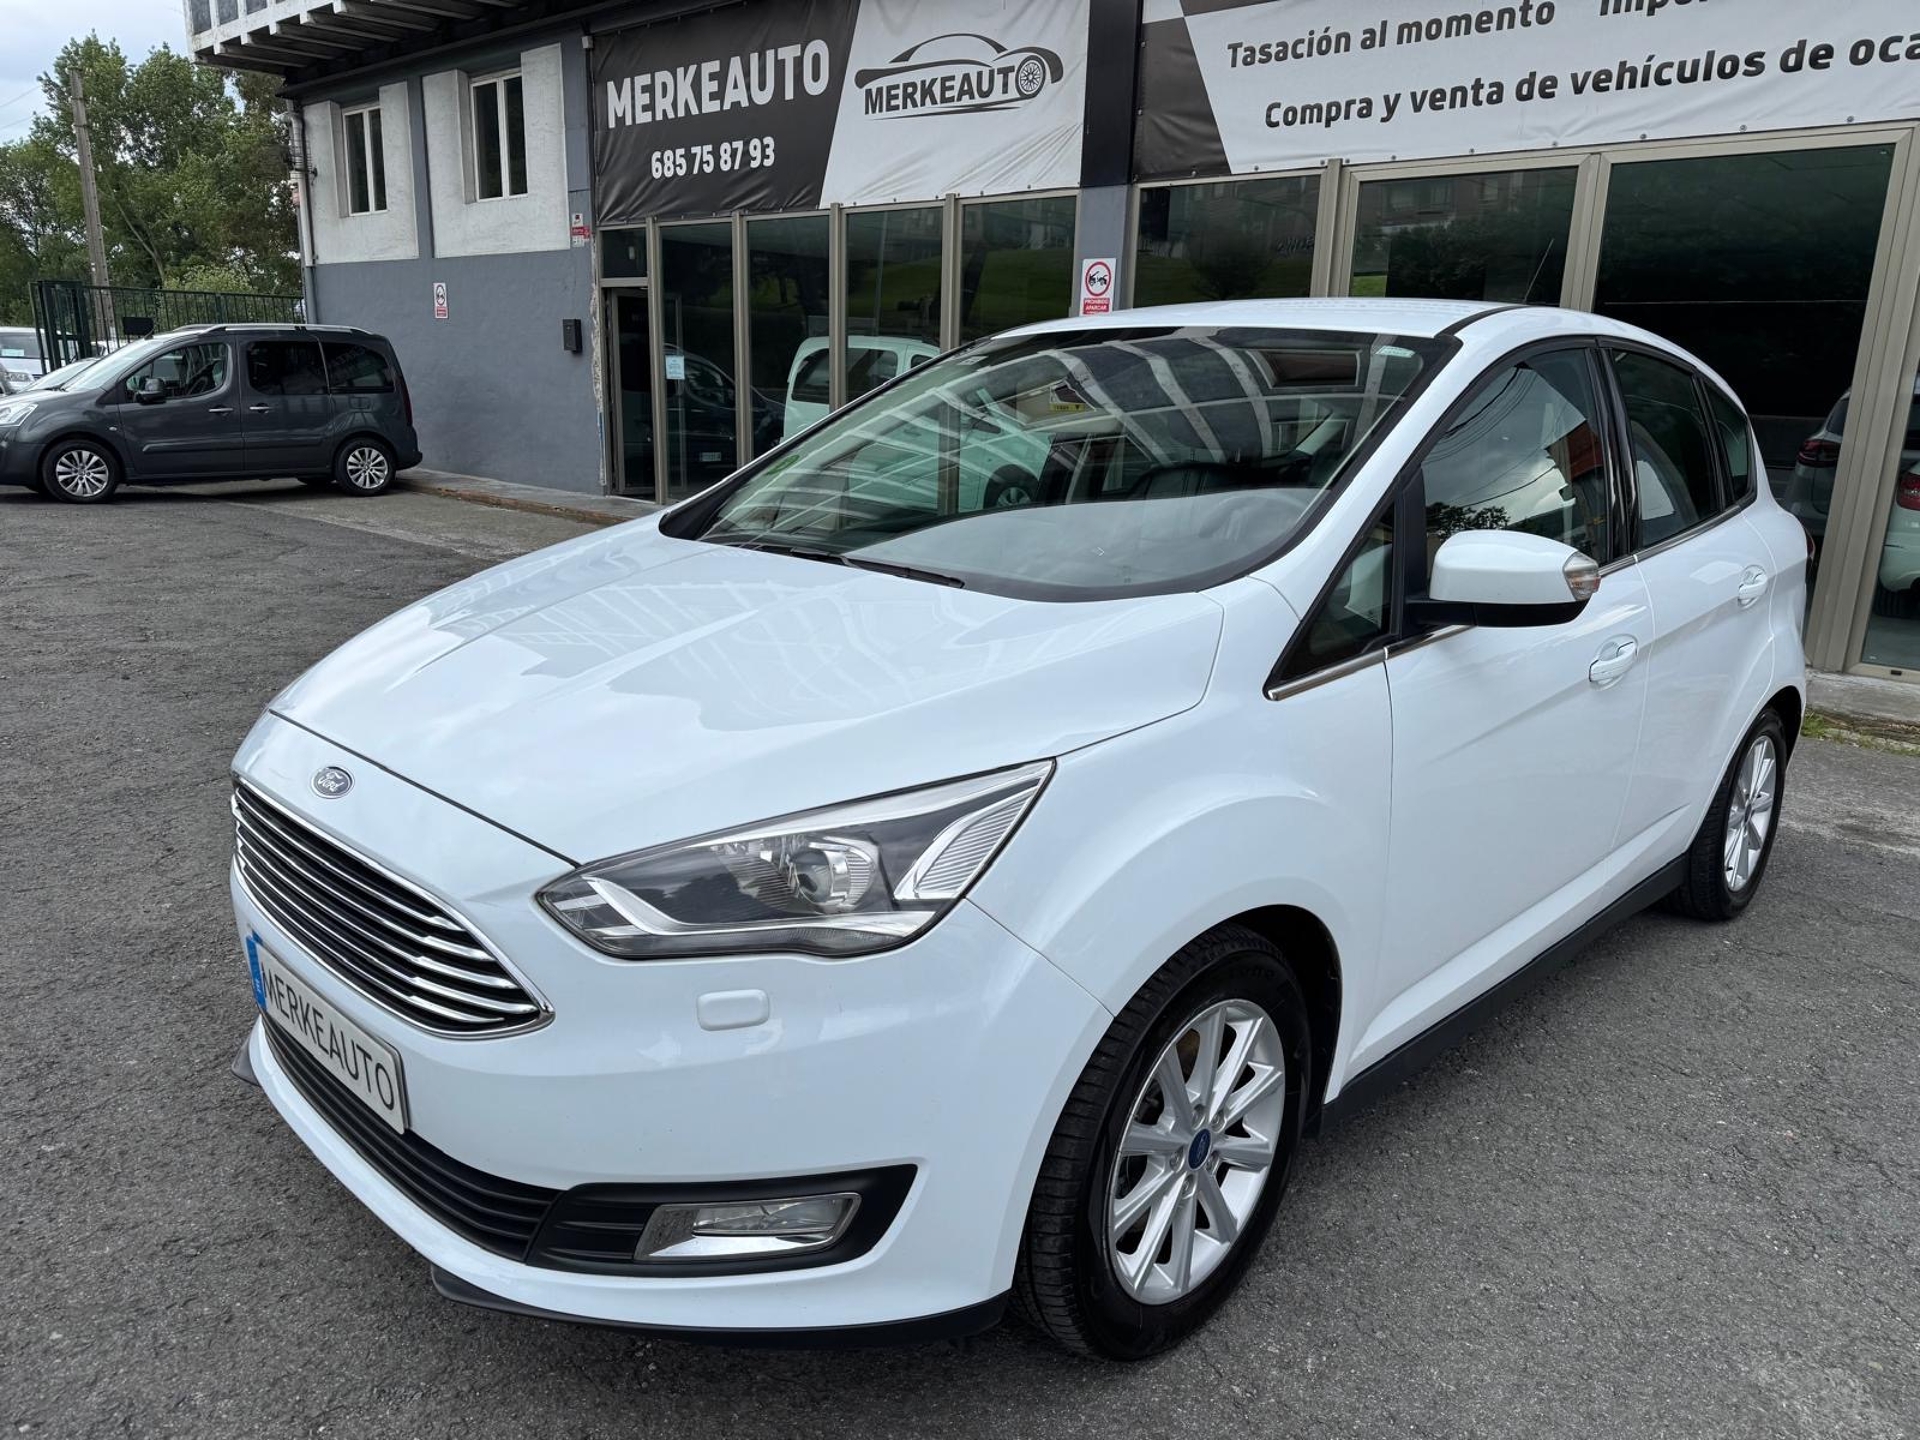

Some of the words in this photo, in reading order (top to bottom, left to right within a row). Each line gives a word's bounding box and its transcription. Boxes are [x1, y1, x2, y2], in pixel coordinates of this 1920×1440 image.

[1227, 26, 1351, 68] Tasación
[1360, 20, 1388, 50] al
[1396, 0, 1555, 46] momento
[606, 39, 830, 130] MERKEAUTO
[1265, 96, 1374, 128] Compra
[1380, 93, 1402, 123] y
[1410, 77, 1504, 114] venta
[1515, 71, 1559, 102] de
[1570, 50, 1766, 95] vehículos
[1779, 39, 1835, 74] de
[651, 148, 687, 180] 685
[691, 144, 715, 175] 75
[719, 140, 744, 172] 87
[749, 136, 775, 169] 93
[260, 961, 396, 1112] MERKEAUTO
